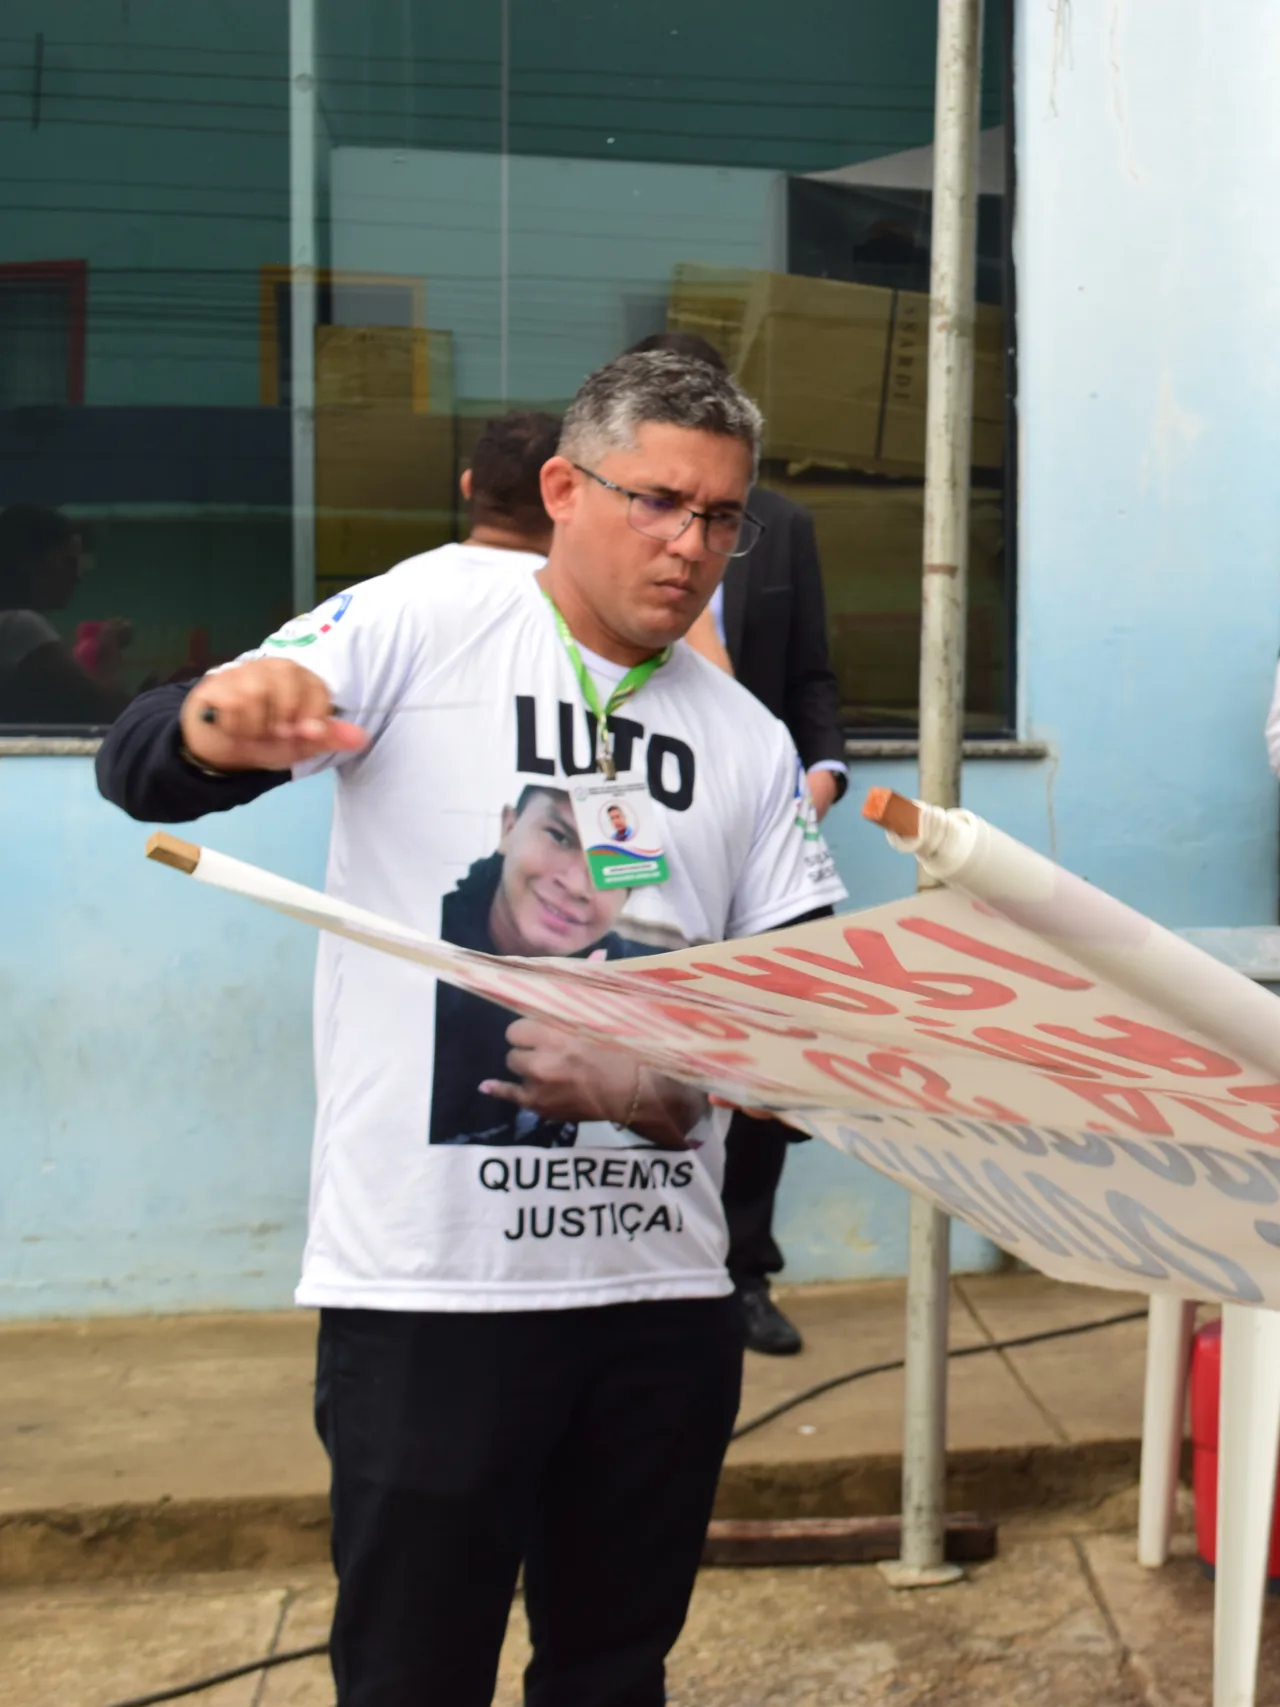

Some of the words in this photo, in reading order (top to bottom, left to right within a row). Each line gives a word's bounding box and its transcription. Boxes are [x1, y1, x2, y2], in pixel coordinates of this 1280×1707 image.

[515, 695, 695, 812] LUTO
[478, 1156, 695, 1194] QUEREMOS
[504, 1201, 685, 1242] JUSTIÇA!
